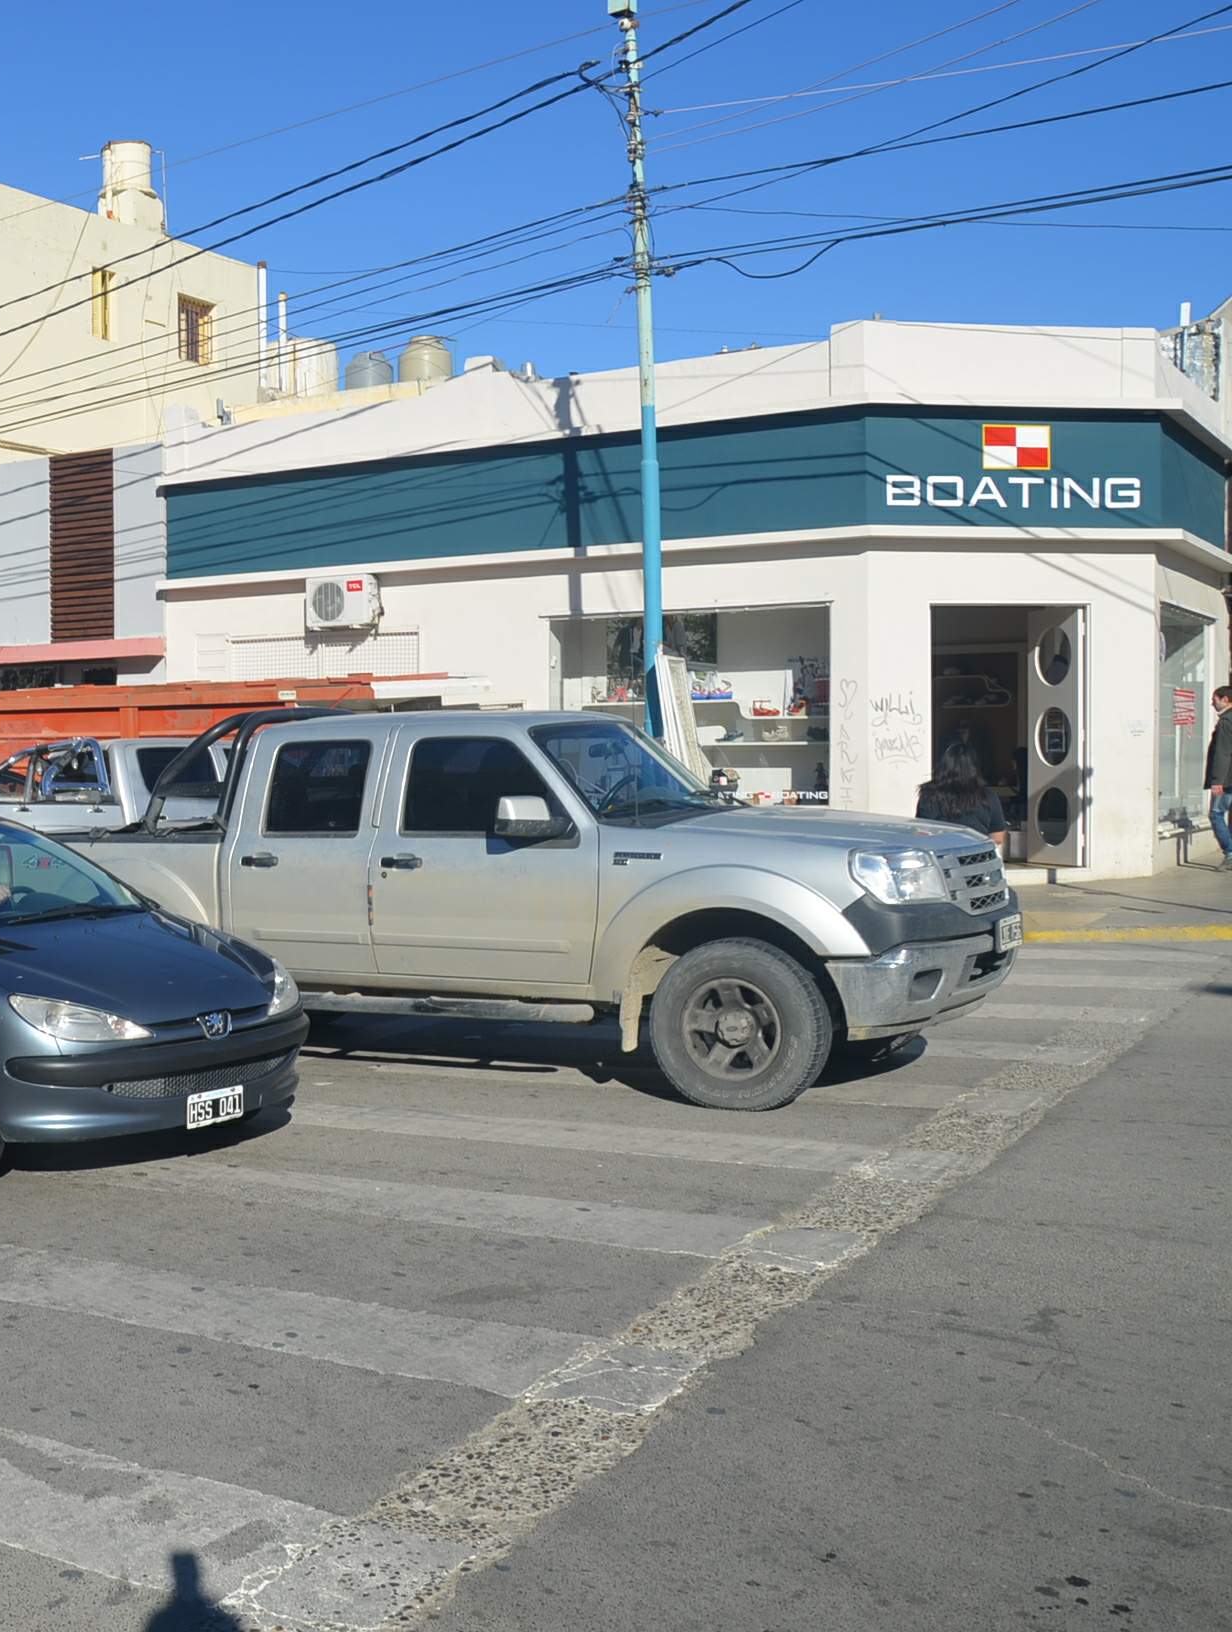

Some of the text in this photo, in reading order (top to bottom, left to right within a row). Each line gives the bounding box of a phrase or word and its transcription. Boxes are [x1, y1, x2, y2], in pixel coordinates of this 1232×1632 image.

[886, 474, 1141, 509] BOATING
[189, 1095, 241, 1123] HSS 041
